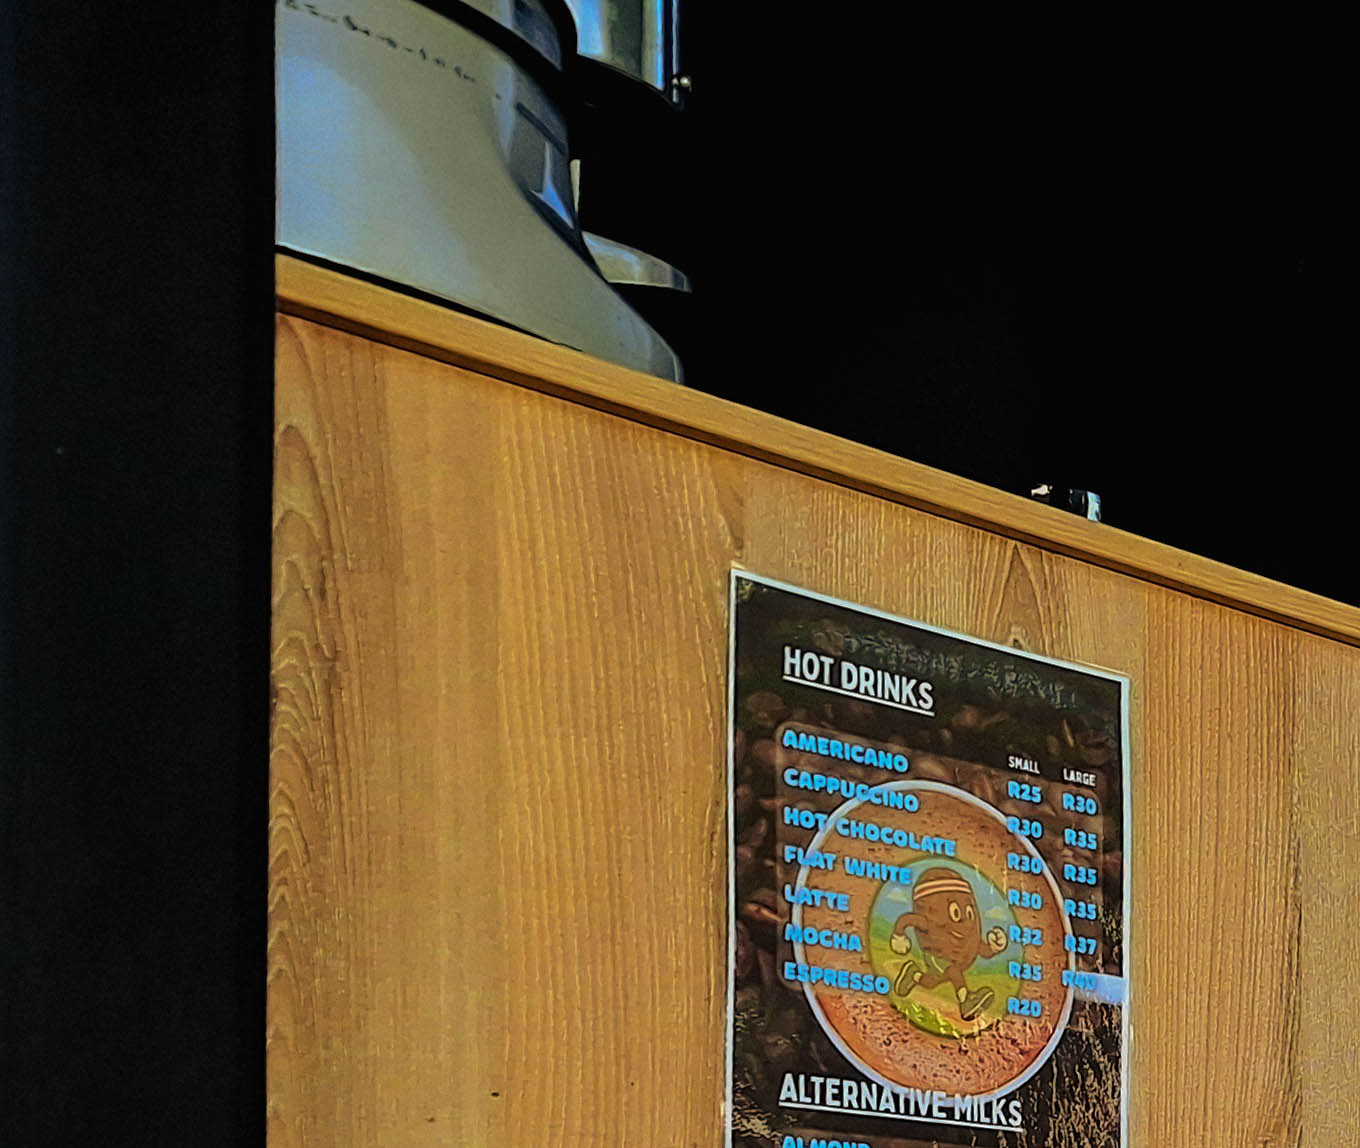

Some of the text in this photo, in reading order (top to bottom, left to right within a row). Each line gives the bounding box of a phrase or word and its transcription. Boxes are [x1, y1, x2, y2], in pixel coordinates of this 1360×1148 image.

[783, 645, 935, 711] HOT DRINKS
[782, 729, 1097, 816] AMERICANO R25 R30
[1008, 755, 1096, 787] SMALL LARGE
[783, 768, 1097, 852] CAPPUCCINO R30 R35
[783, 806, 1097, 886] HOT CHOCOLATE R30 R35
[783, 846, 1097, 921] FLAT WHITE R30 R35
[783, 884, 1097, 955] LATTE R32 R37
[784, 923, 862, 953] MOCHA
[1008, 960, 1042, 982] R35
[784, 961, 1042, 1018] ESPRESSO R20
[779, 1072, 1022, 1128] ALTERNATIVE MILKS
